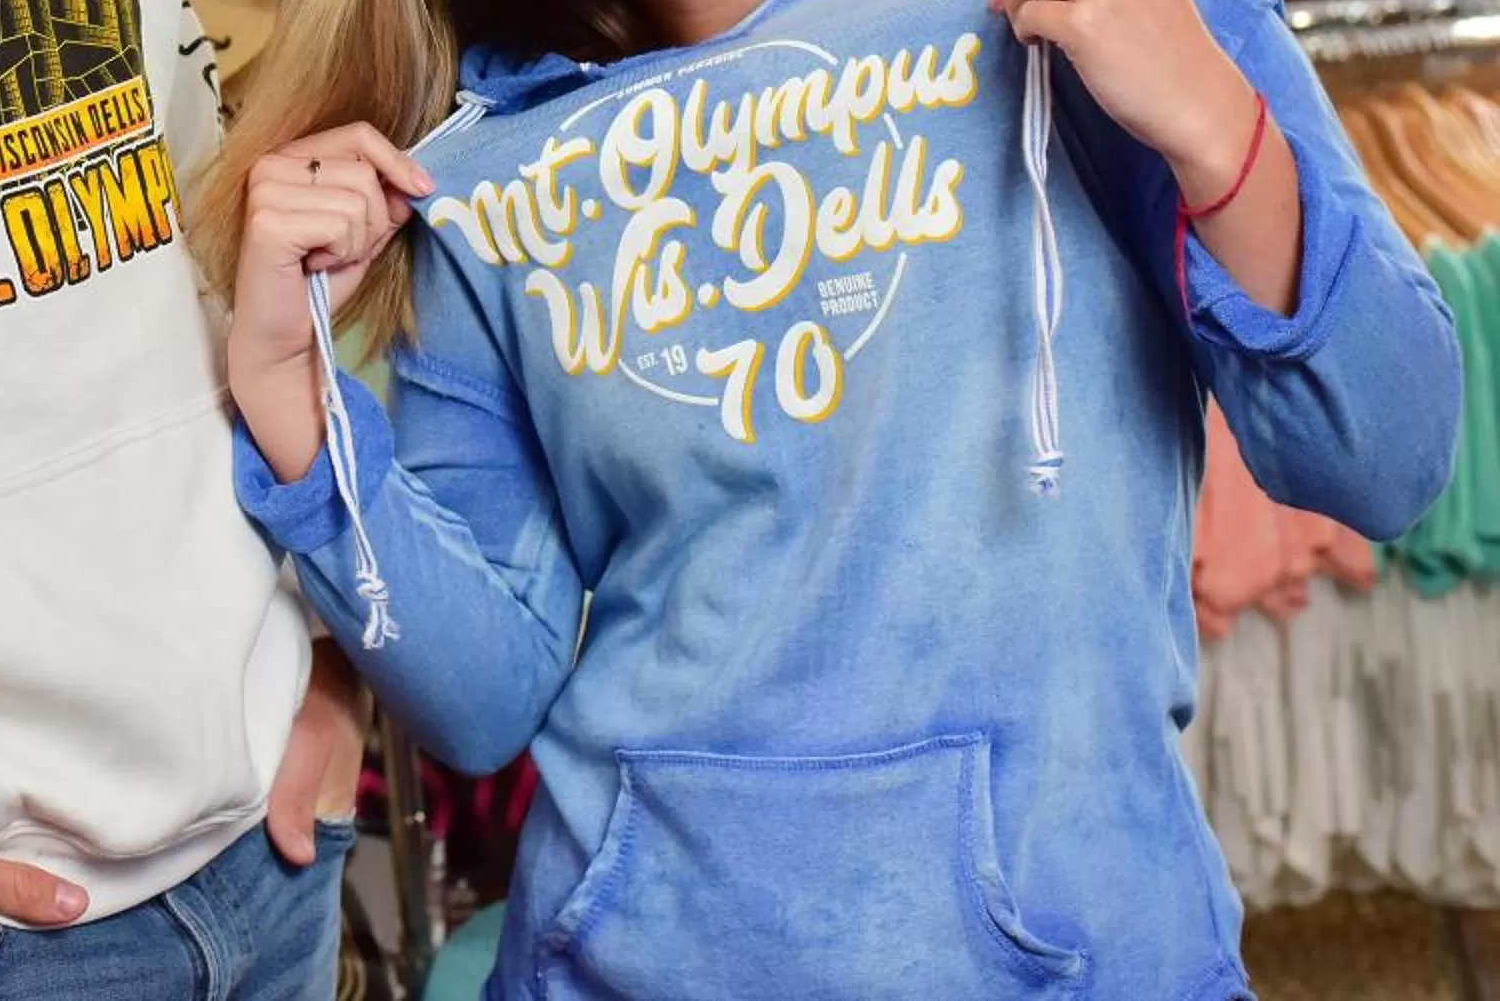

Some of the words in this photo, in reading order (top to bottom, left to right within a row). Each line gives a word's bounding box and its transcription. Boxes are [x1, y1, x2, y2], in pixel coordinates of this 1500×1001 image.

[87, 87, 146, 139] DELLS
[428, 136, 600, 268] Mt.
[599, 32, 981, 211] Olympus
[0, 135, 184, 298] OLYMP
[711, 135, 966, 311] Dells
[817, 271, 875, 298] GENUINE
[820, 290, 880, 317] PRODUCT
[661, 344, 688, 376] 19
[697, 320, 845, 443] 70
